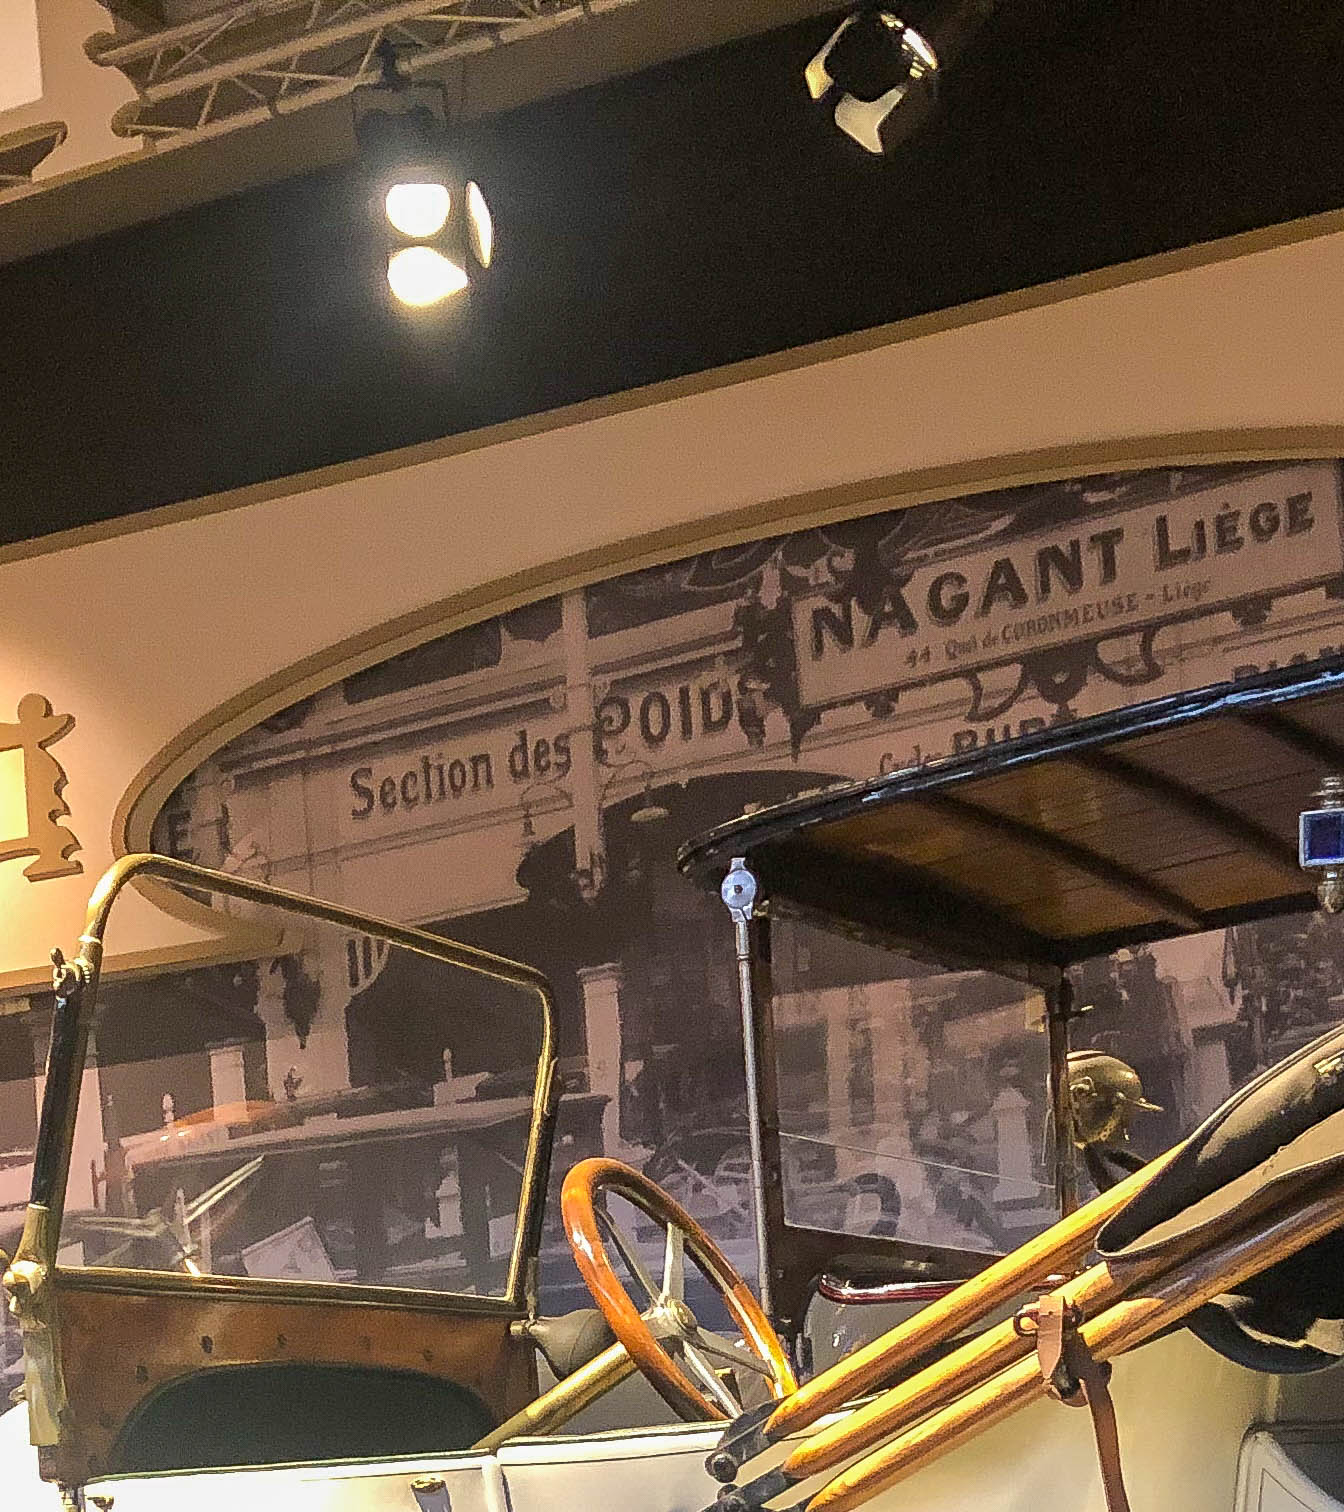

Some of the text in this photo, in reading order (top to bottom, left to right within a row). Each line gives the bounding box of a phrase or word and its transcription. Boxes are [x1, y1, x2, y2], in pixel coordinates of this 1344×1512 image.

[810, 527, 1125, 662] NAGANT
[350, 750, 495, 819] Section
[508, 728, 572, 780] des
